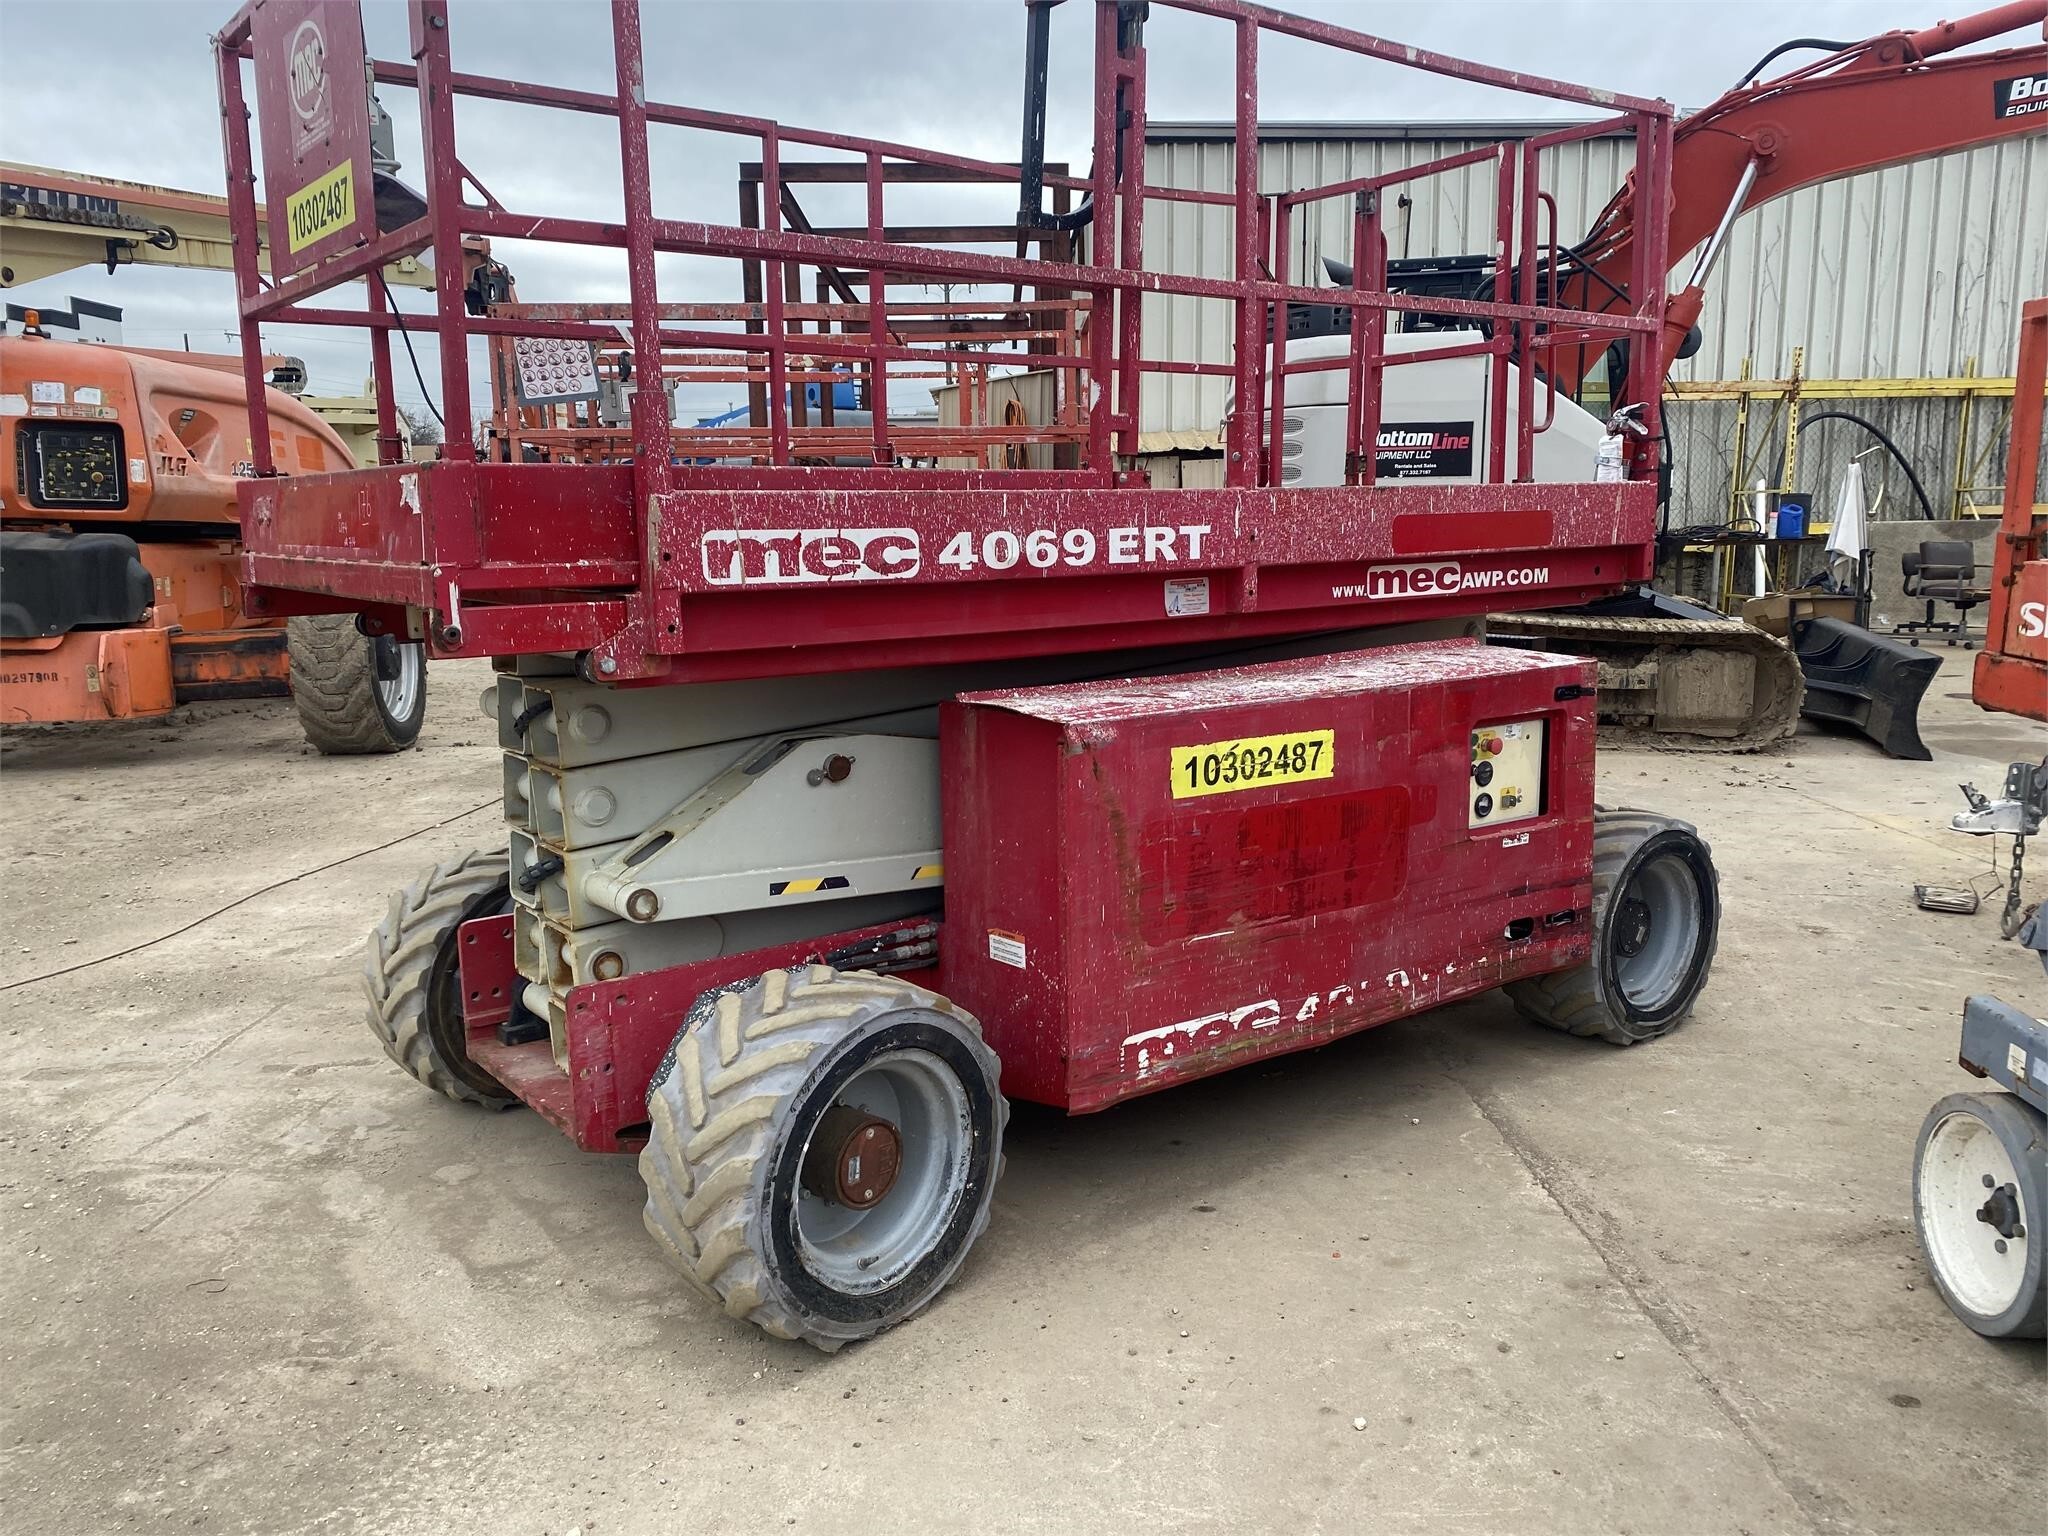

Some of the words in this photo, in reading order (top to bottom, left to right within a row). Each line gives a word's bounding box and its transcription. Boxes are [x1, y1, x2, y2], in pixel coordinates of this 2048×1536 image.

[293, 38, 322, 101] mec
[292, 175, 349, 241] 10302487
[156, 455, 187, 477] JLG
[1415, 450, 1432, 459] LLC
[703, 536, 918, 579] mec
[938, 528, 1096, 571] 4069
[1108, 525, 1211, 564] ERT
[2018, 602, 2048, 639] S
[1185, 740, 1324, 788] 10302487
